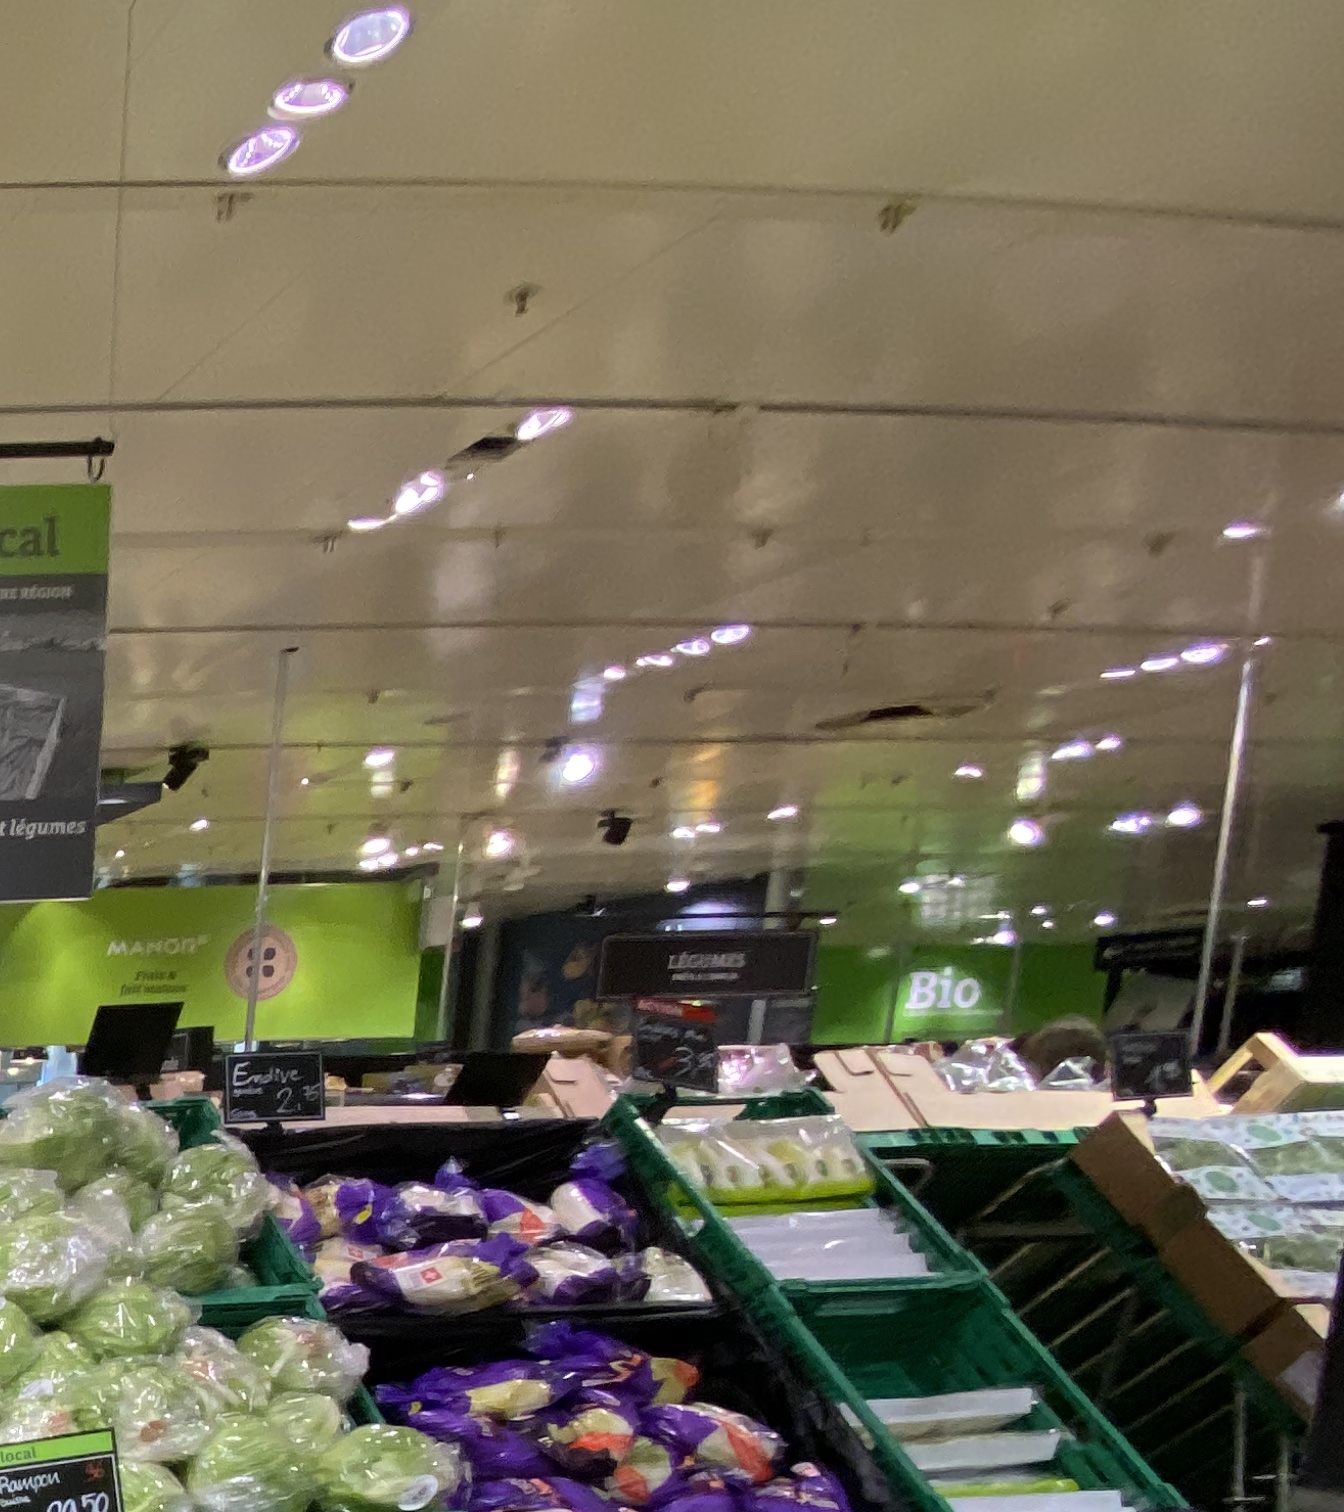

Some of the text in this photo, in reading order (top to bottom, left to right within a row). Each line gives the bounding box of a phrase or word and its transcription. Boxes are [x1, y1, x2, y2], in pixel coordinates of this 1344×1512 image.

[9, 817, 87, 841] légumes
[905, 966, 982, 1010] Bio
[0, 1447, 37, 1464] local
